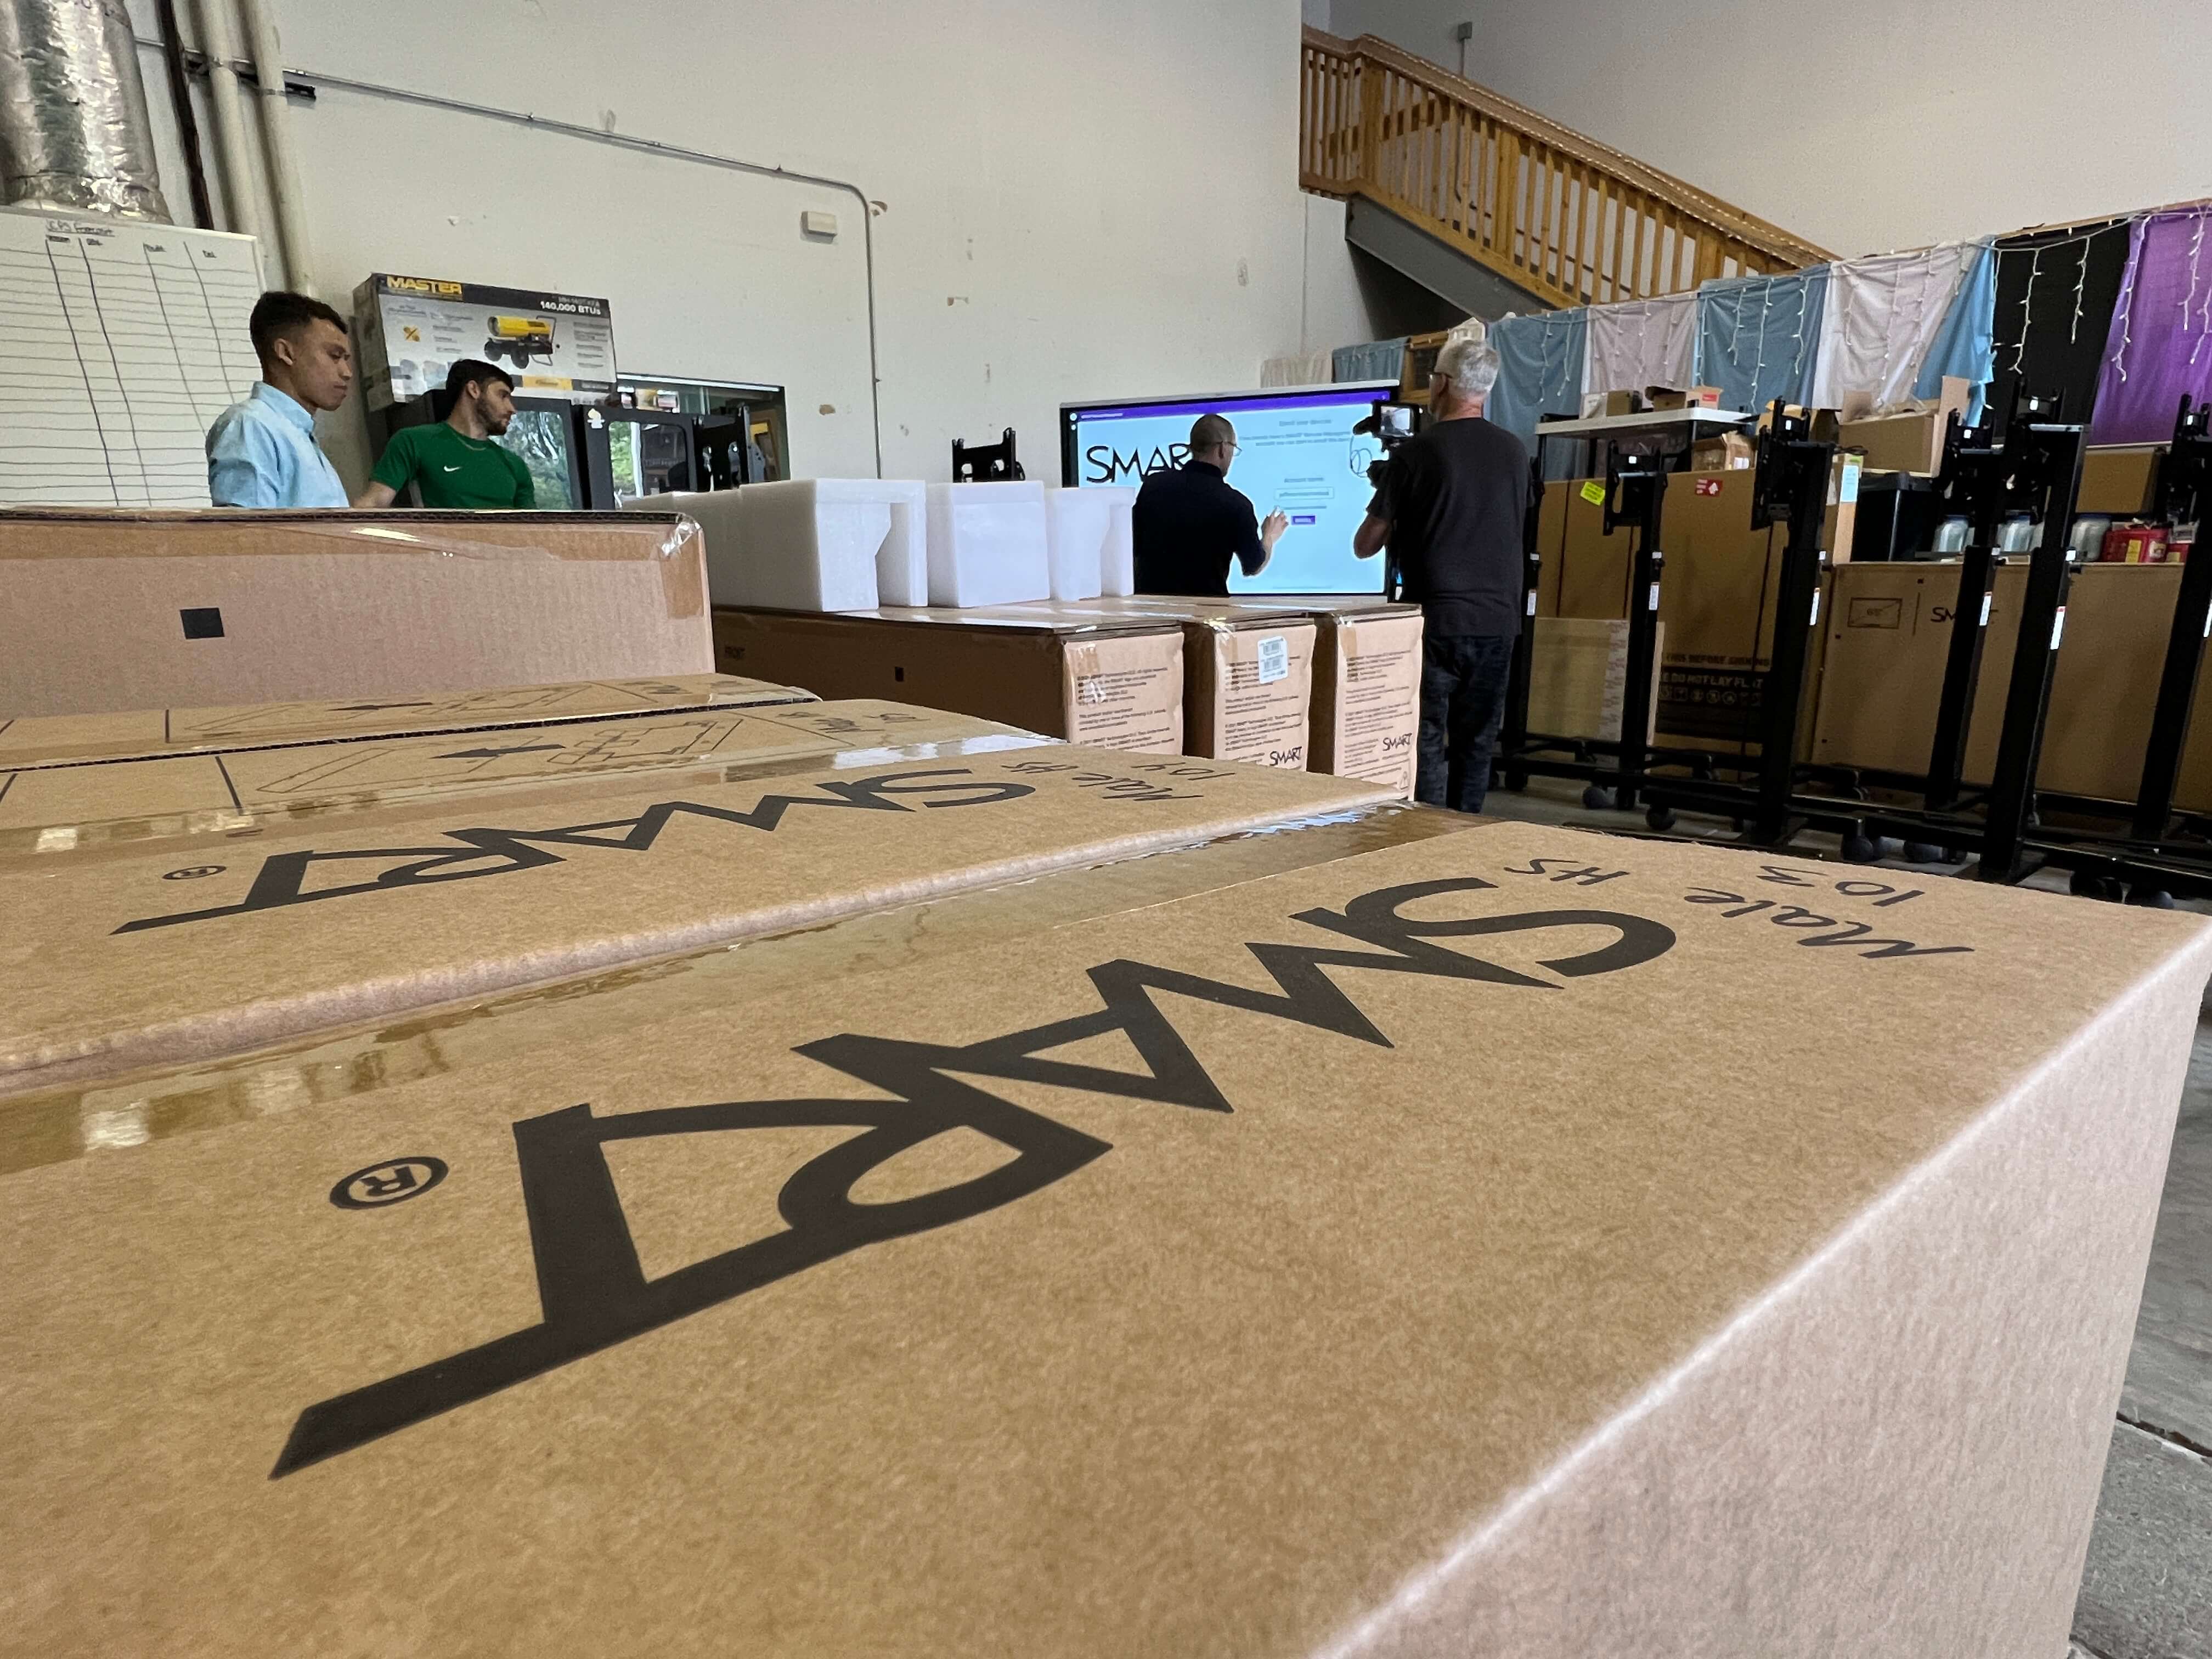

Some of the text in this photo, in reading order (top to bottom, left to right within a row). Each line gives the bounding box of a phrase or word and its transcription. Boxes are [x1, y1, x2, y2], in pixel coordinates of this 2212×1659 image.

[386, 275, 462, 295] MASTER
[540, 300, 601, 315] 140,000 BTUs
[1086, 442, 1191, 483] SMAR
[1383, 733, 1413, 752] SMART
[1269, 746, 1303, 766] SMART
[110, 769, 1036, 935] SMART
[269, 877, 1677, 1480] SMART
